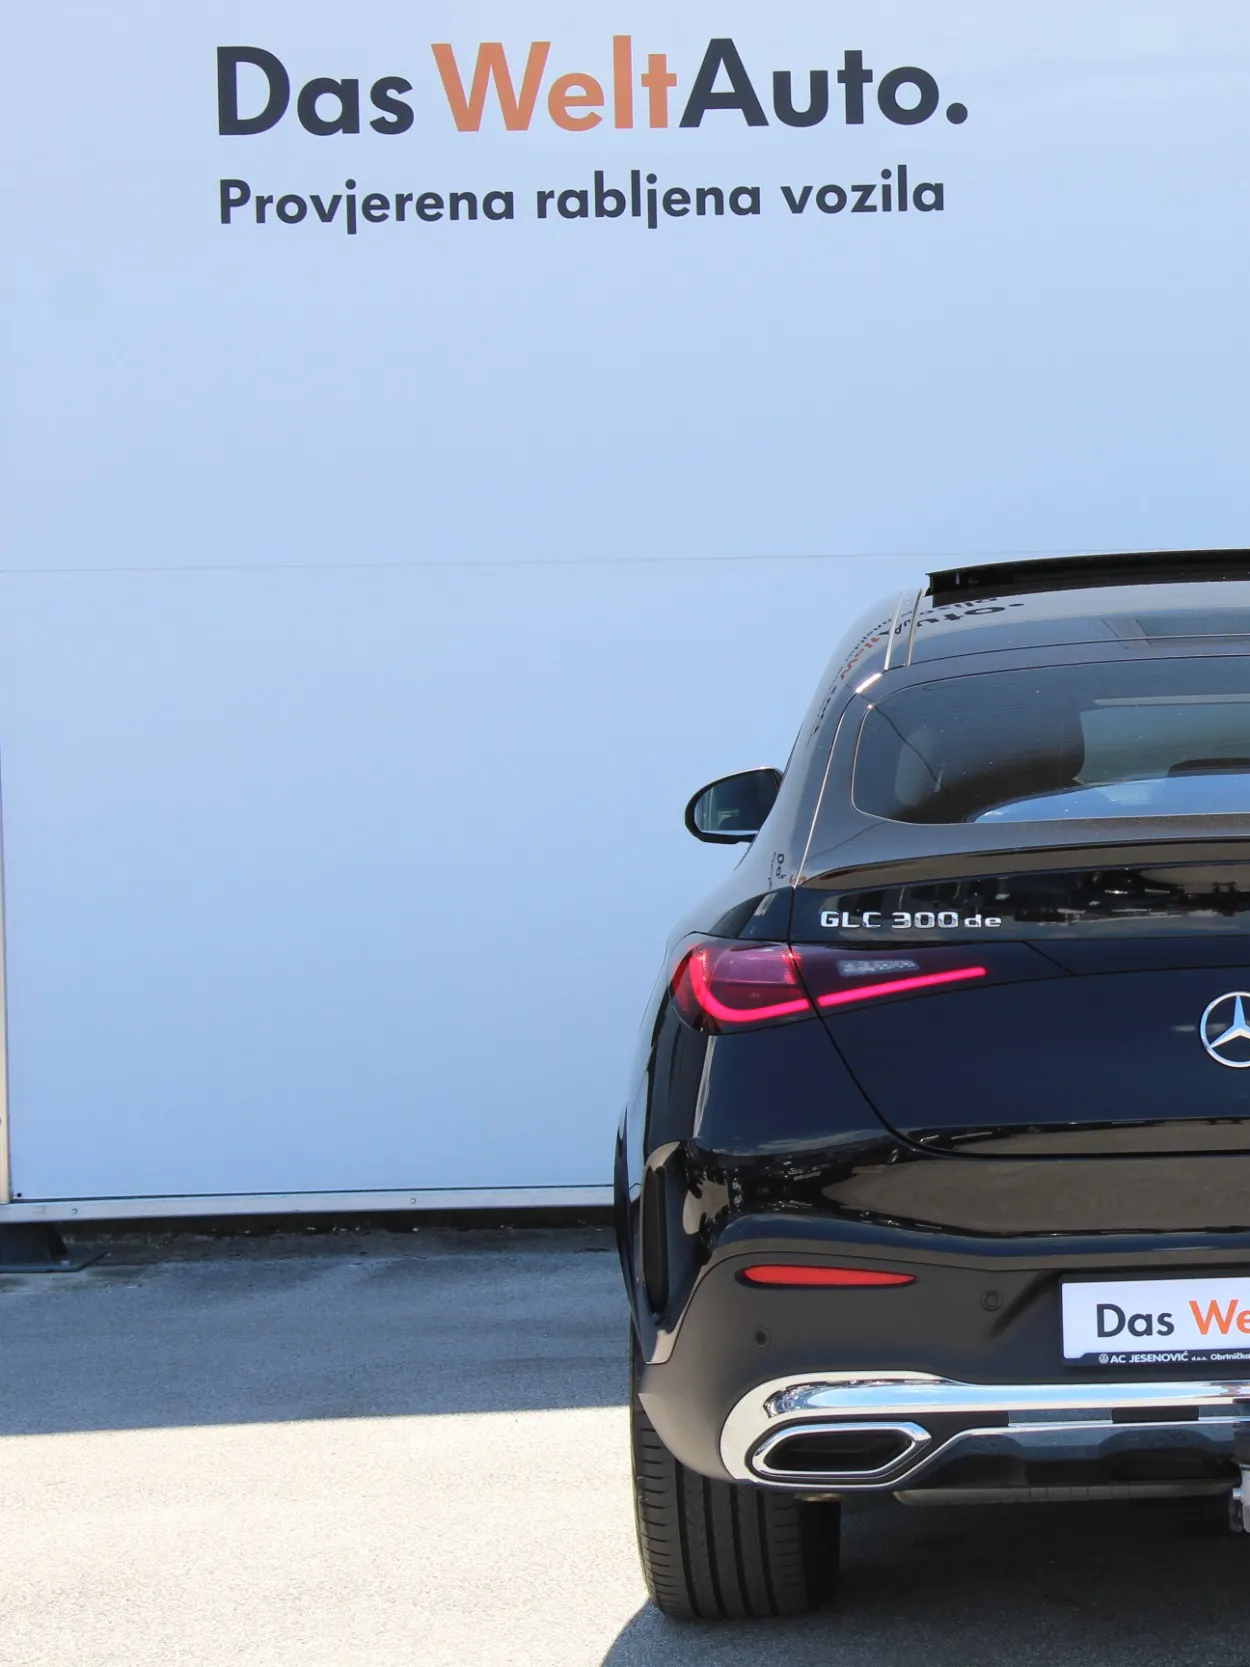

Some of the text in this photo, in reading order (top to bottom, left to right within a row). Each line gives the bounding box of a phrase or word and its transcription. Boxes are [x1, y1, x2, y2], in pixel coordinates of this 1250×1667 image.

[216, 35, 969, 137] Das WeltAuto.
[219, 164, 945, 235] Provjerena rabljena vozila
[820, 911, 882, 928] GLC
[1096, 1303, 1175, 1338] Das
[1110, 1355, 1127, 1364] AC
[1129, 1350, 1189, 1363] JESENOVIĆ
[1210, 1351, 1250, 1361] Obrtnička
